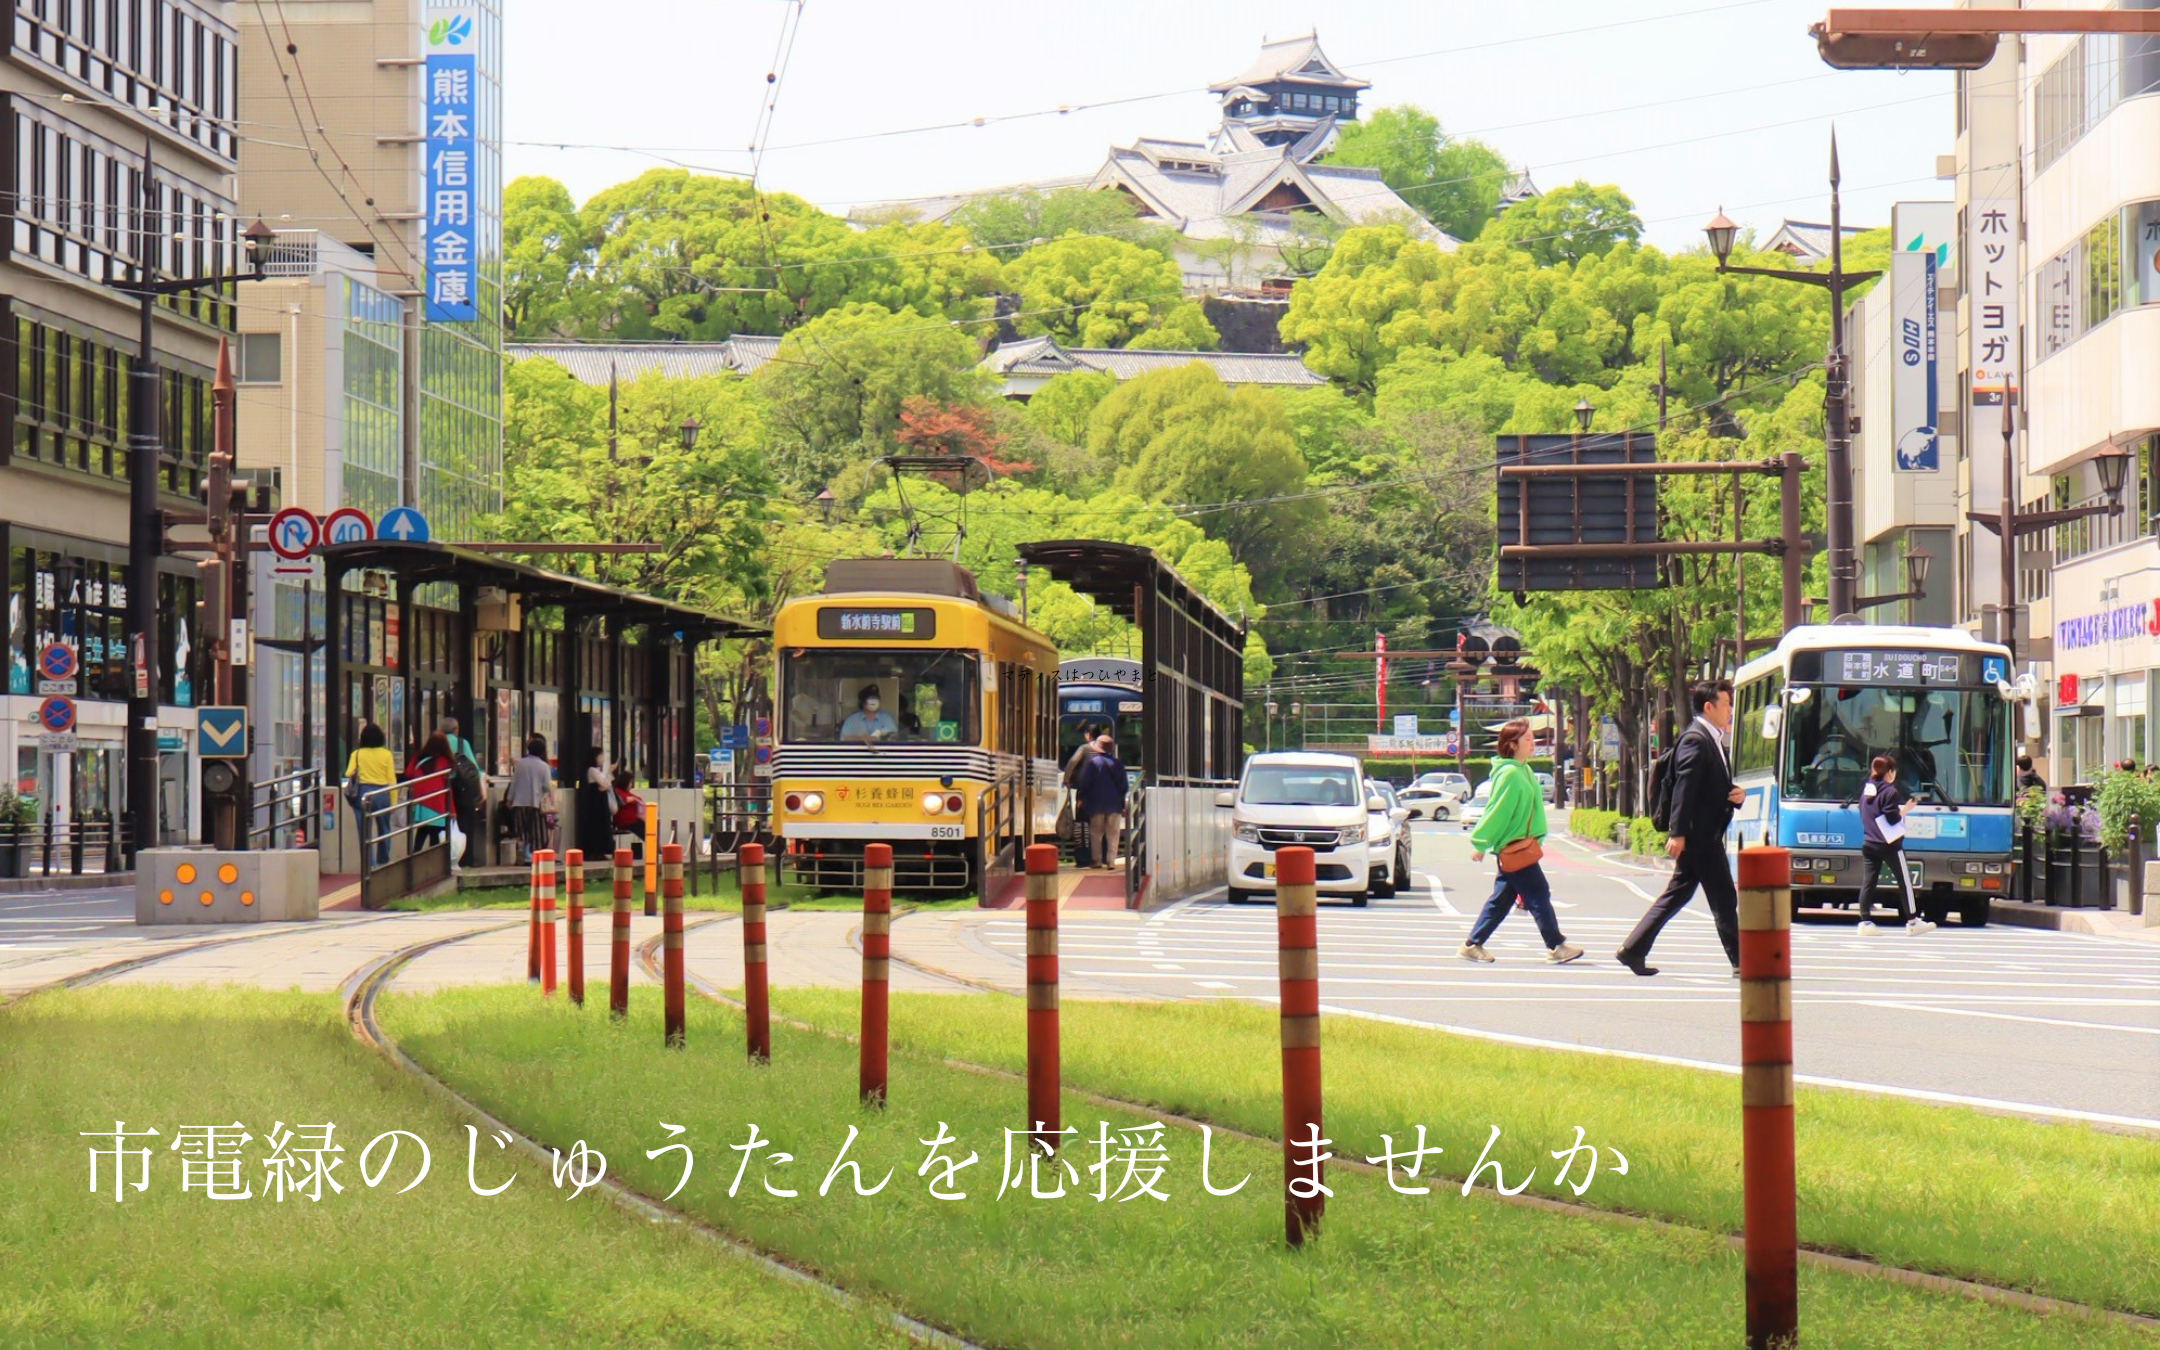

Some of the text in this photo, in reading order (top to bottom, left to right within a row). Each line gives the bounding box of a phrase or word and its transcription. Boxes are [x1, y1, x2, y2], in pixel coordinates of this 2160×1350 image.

[432, 68, 468, 305] 熊本信用金庫
[1980, 209, 2009, 363] ホットヨガ
[1903, 318, 1920, 366] HIS
[1987, 371, 2014, 379] LAVA
[1989, 392, 2001, 402] 3F
[335, 523, 363, 543] 40
[841, 613, 901, 630] 新水前寺駅前
[1873, 662, 1938, 680] 水道町
[41, 683, 74, 693] ここまで
[856, 787, 914, 800] 杉養蜂園
[931, 827, 960, 837] 8501
